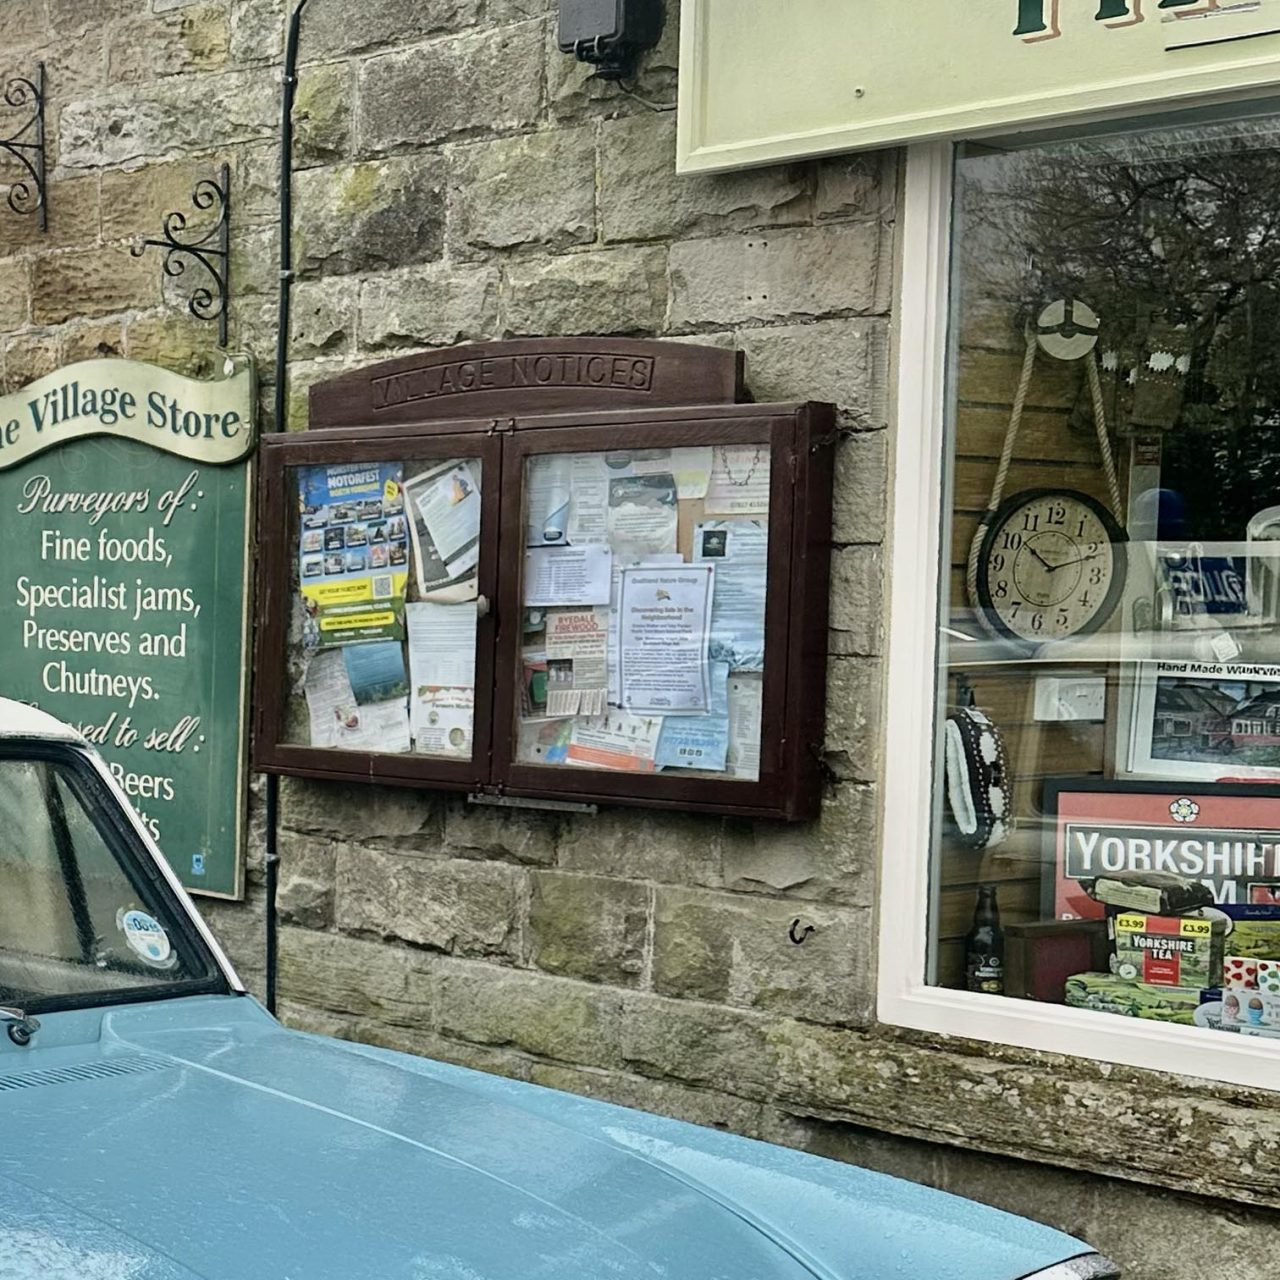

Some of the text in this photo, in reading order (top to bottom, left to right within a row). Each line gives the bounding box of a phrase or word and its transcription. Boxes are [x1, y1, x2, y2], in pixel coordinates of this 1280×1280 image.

[374, 356, 648, 405] VILLAGE NOTICES
[28, 381, 137, 433] Village
[147, 391, 240, 438] Store
[17, 474, 150, 525] Purveyors
[1022, 514, 1039, 531] 11
[1045, 507, 1066, 525] 12
[1077, 520, 1085, 537] 1
[41, 528, 173, 567] Fine foods,
[1002, 533, 1022, 550] 10
[993, 554, 1005, 572] 9
[1089, 567, 1101, 584] 3
[16, 576, 201, 620] Specialist jams,
[995, 580, 1008, 598] 8
[1078, 590, 1089, 606] 4
[1011, 601, 1022, 618] 7
[1056, 609, 1068, 626] 5
[555, 622, 598, 634] FIREWOOD
[1031, 613, 1042, 630] 6
[23, 620, 186, 657] Preserves and
[1157, 662, 1187, 672] Hand
[1190, 663, 1223, 674] Made
[42, 660, 160, 708] Chutneys.
[115, 717, 138, 747] to
[109, 762, 175, 800] Beers
[1076, 831, 1280, 876] YORKSHIR
[1118, 918, 1144, 929] £3.99
[1183, 924, 1210, 934] £3.99
[1132, 934, 1194, 952] YORKSHIRE
[1152, 949, 1173, 960] TEA
